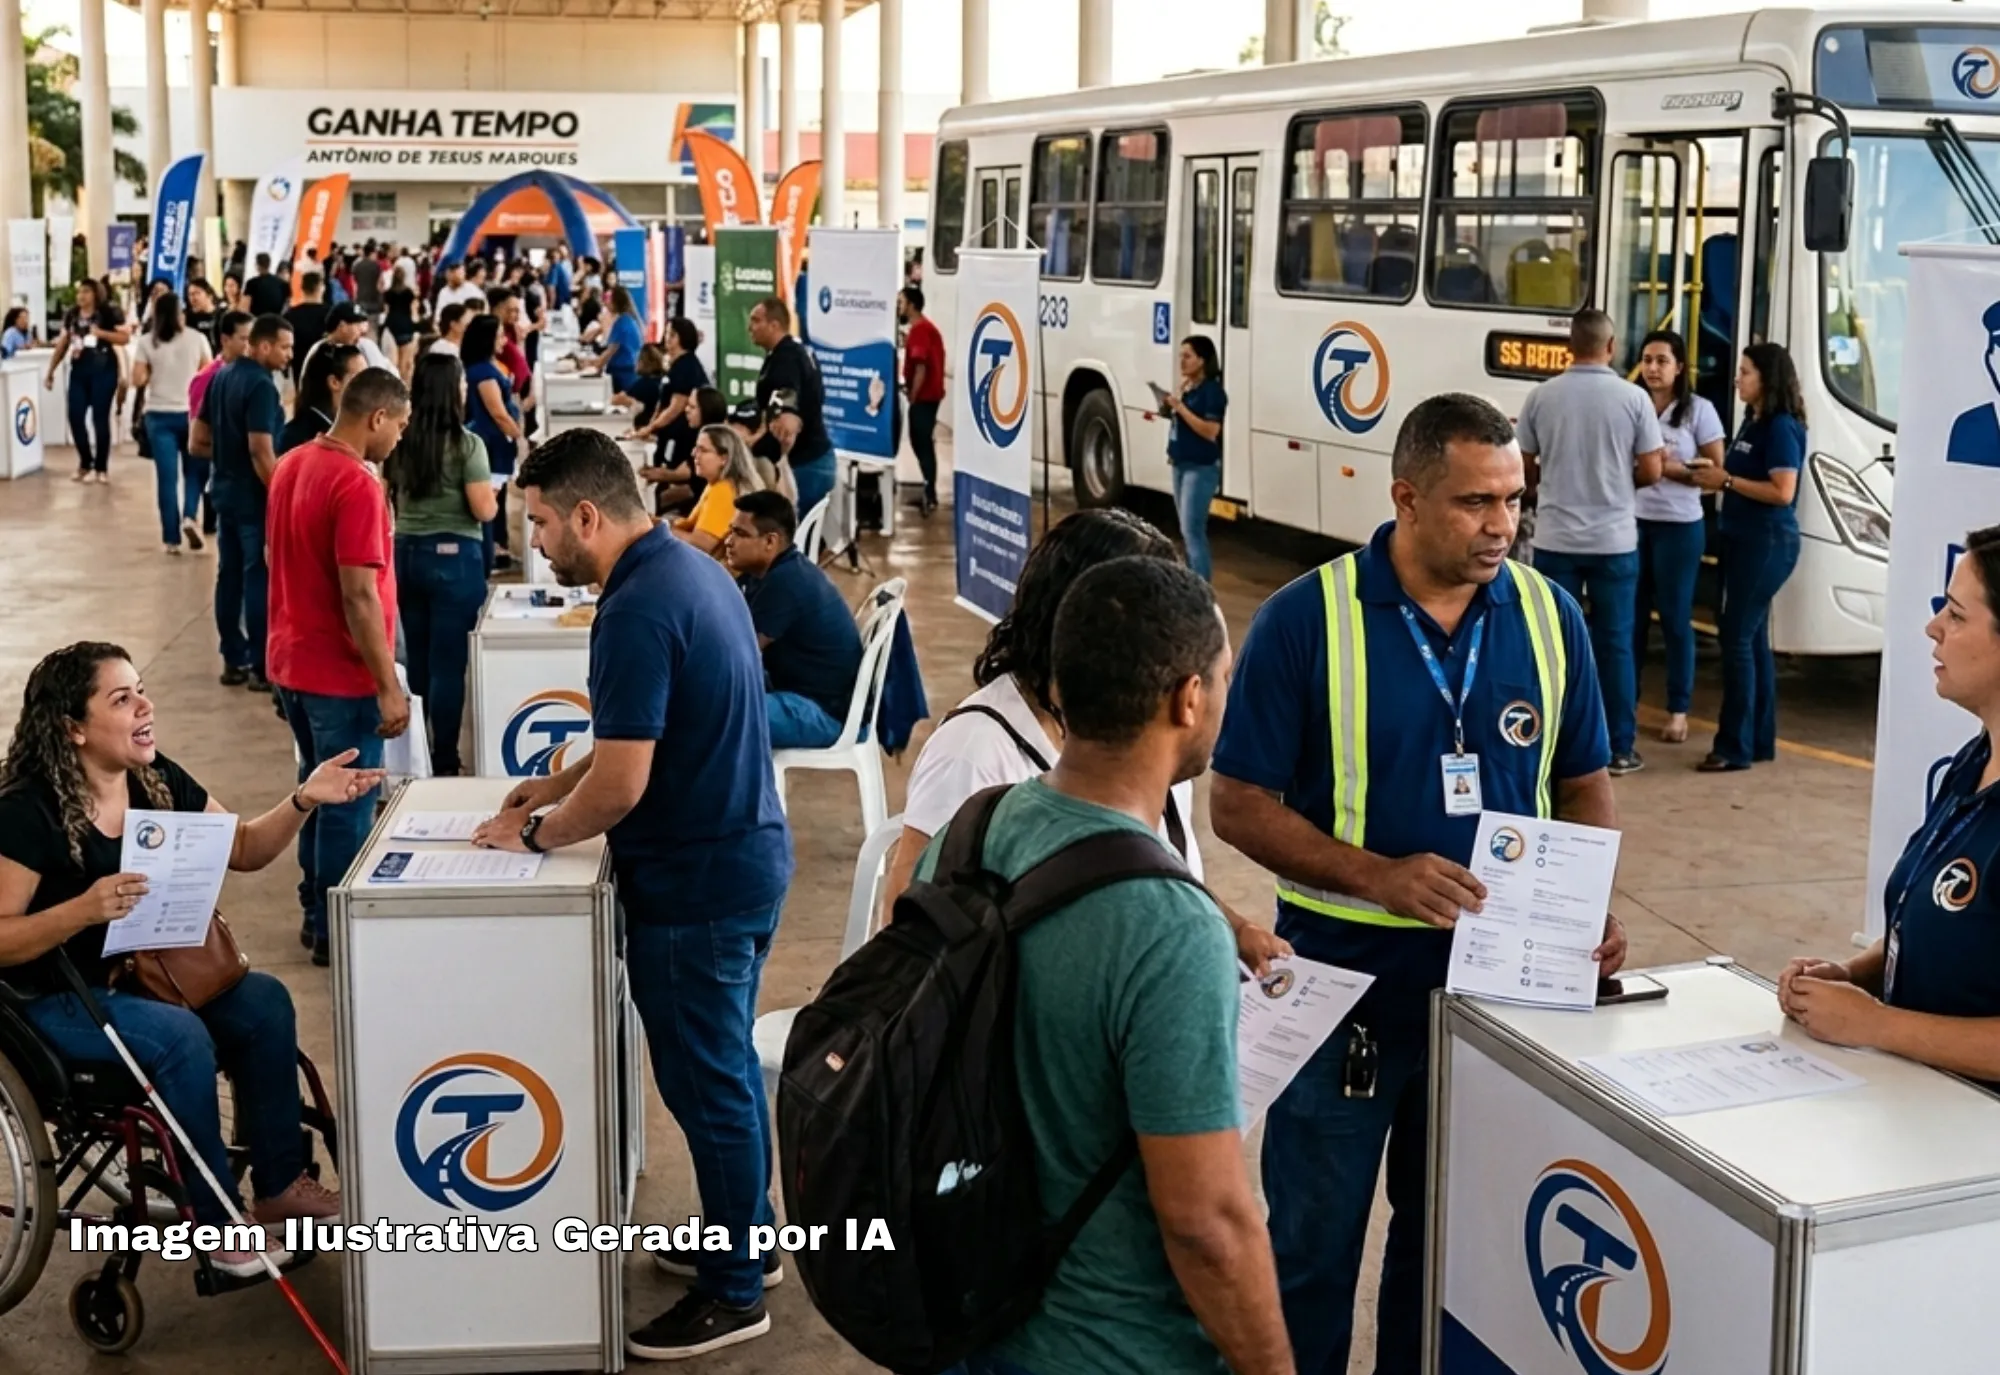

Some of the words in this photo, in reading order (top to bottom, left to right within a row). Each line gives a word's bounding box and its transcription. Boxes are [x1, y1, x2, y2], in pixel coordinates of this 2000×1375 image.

[307, 107, 443, 137] GANHA
[450, 109, 580, 138] TEMPO
[306, 147, 392, 164] ANTÔNIO
[397, 150, 423, 164] DE
[488, 151, 578, 166] MARQUES
